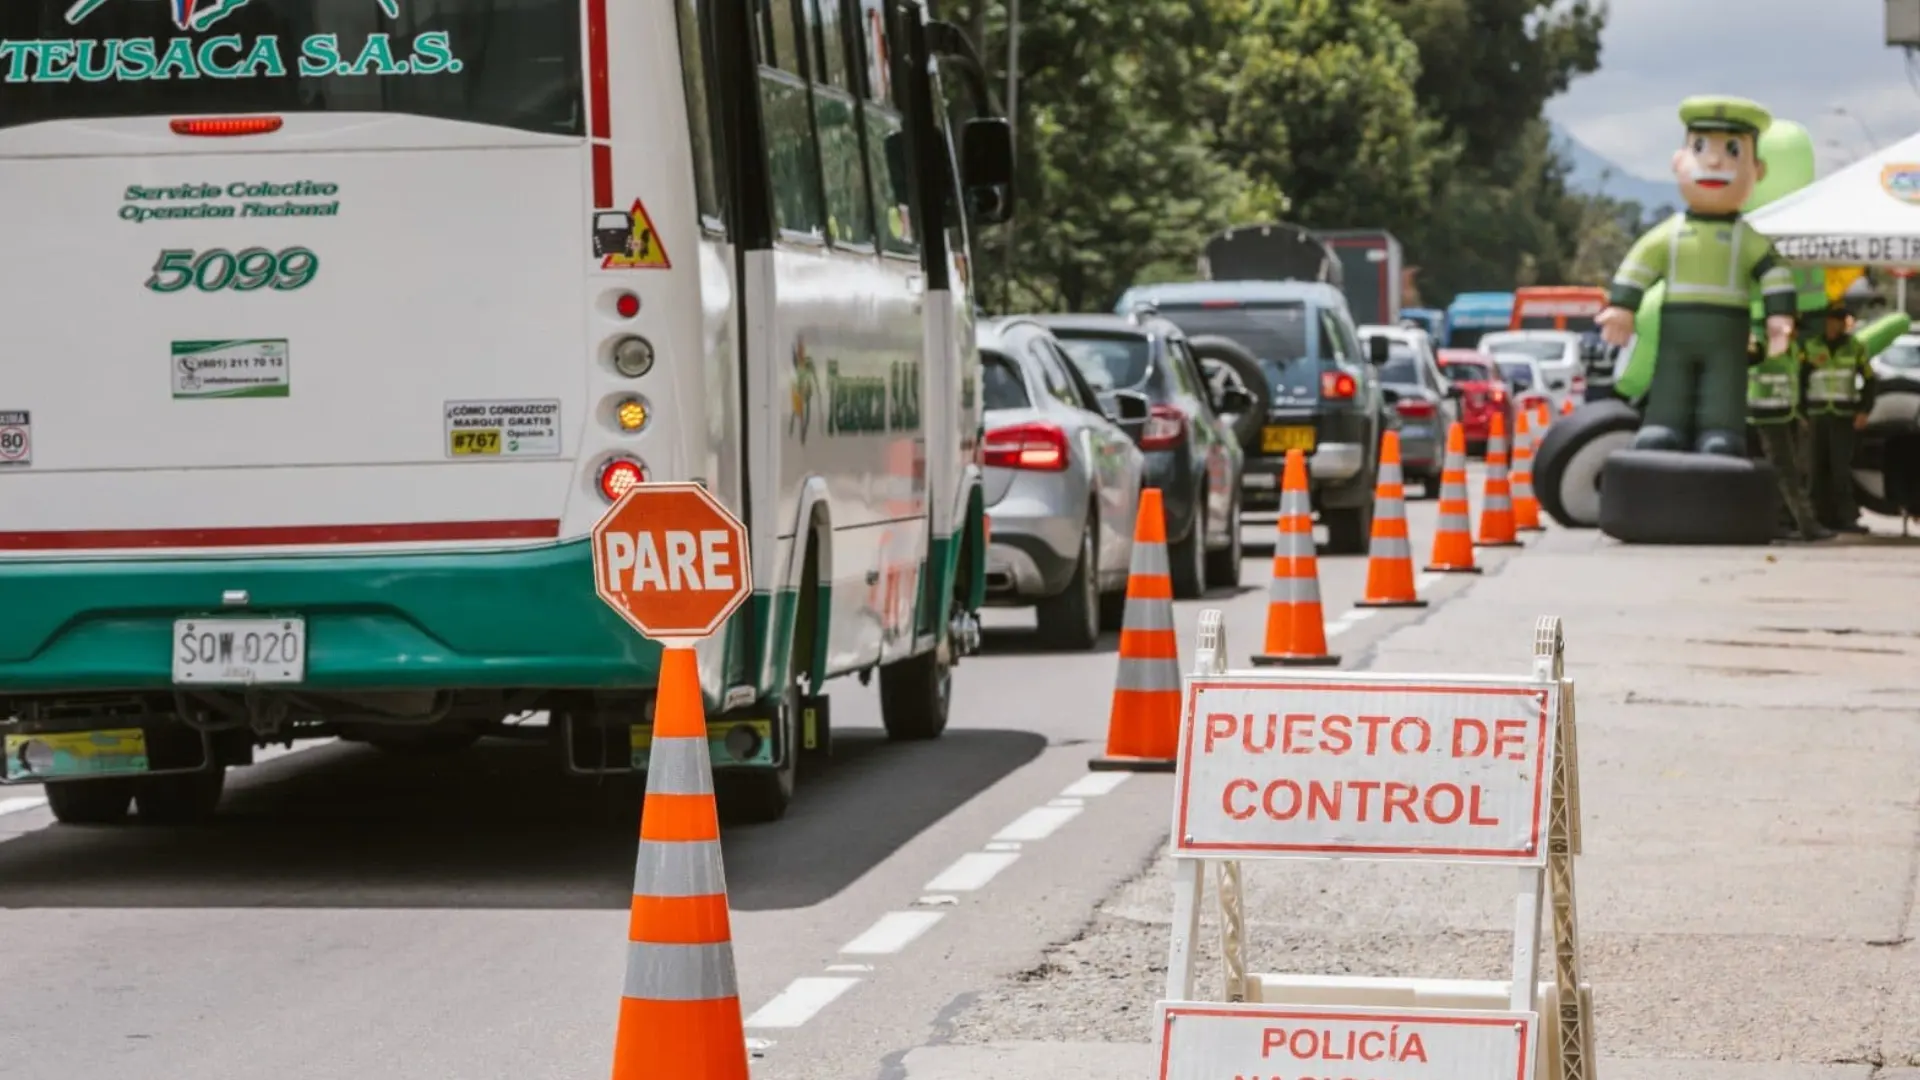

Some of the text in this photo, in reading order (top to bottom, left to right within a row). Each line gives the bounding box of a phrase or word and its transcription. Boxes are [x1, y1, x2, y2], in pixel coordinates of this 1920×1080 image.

[0, 32, 462, 82] TEUSACA S.A.S.
[124, 180, 338, 200] Servicio Colectivo
[118, 200, 339, 223] Operacion Nacional
[1868, 237, 1893, 260] DE
[144, 246, 319, 292] 5099
[453, 416, 551, 427] MARQUE GRATIS
[1, 433, 23, 448] 80
[605, 530, 734, 592] PARE
[243, 631, 298, 663] 020
[1204, 713, 1527, 760] PUESTO DE
[1222, 778, 1499, 826] CONTROL
[1261, 1024, 1428, 1063] POLICÍA
